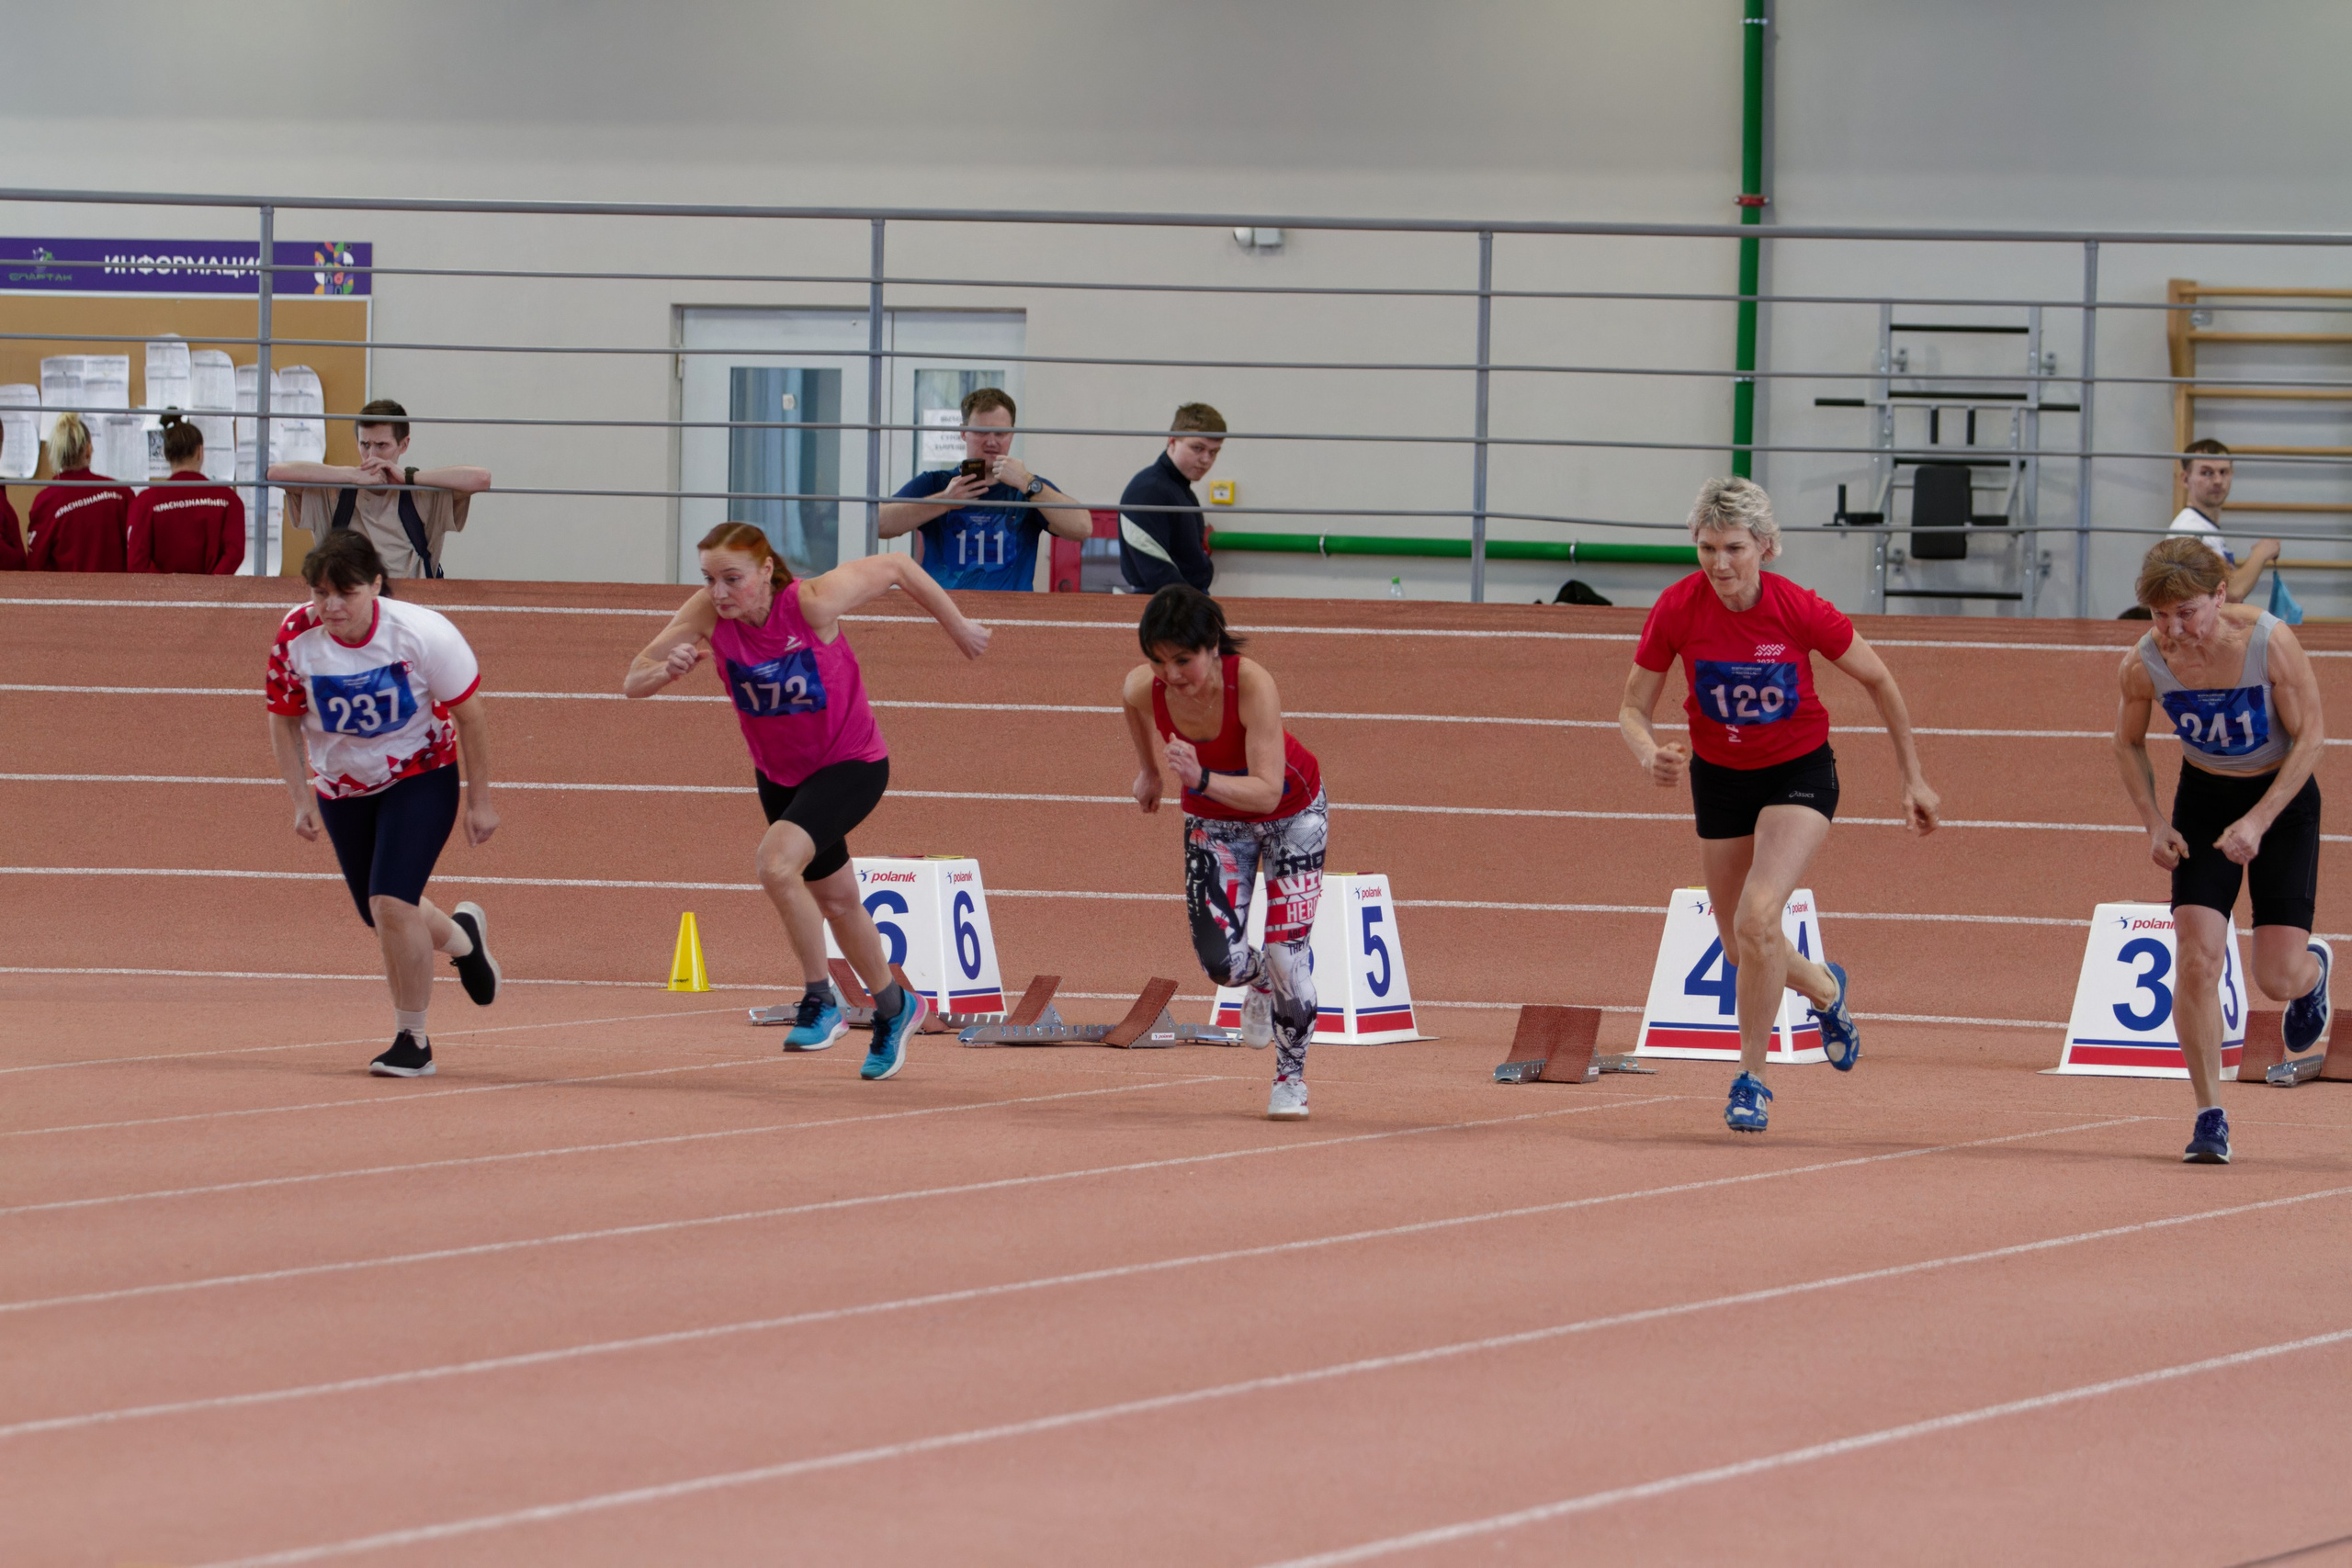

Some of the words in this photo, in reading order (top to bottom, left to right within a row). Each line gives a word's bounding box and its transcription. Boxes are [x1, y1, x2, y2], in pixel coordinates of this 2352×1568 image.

[956, 529, 1004, 565] 111
[328, 686, 400, 734] 237
[740, 675, 813, 712] 172
[1710, 684, 1785, 717] 120
[2179, 710, 2255, 748] 241
[870, 871, 916, 884] polanik
[953, 871, 973, 885] polanik
[1362, 886, 1382, 901] polanik
[953, 890, 981, 980] 6
[2132, 918, 2174, 931] polani
[1362, 906, 1391, 998] 5
[1684, 934, 1738, 1015] 4
[2112, 938, 2173, 1032] 3
